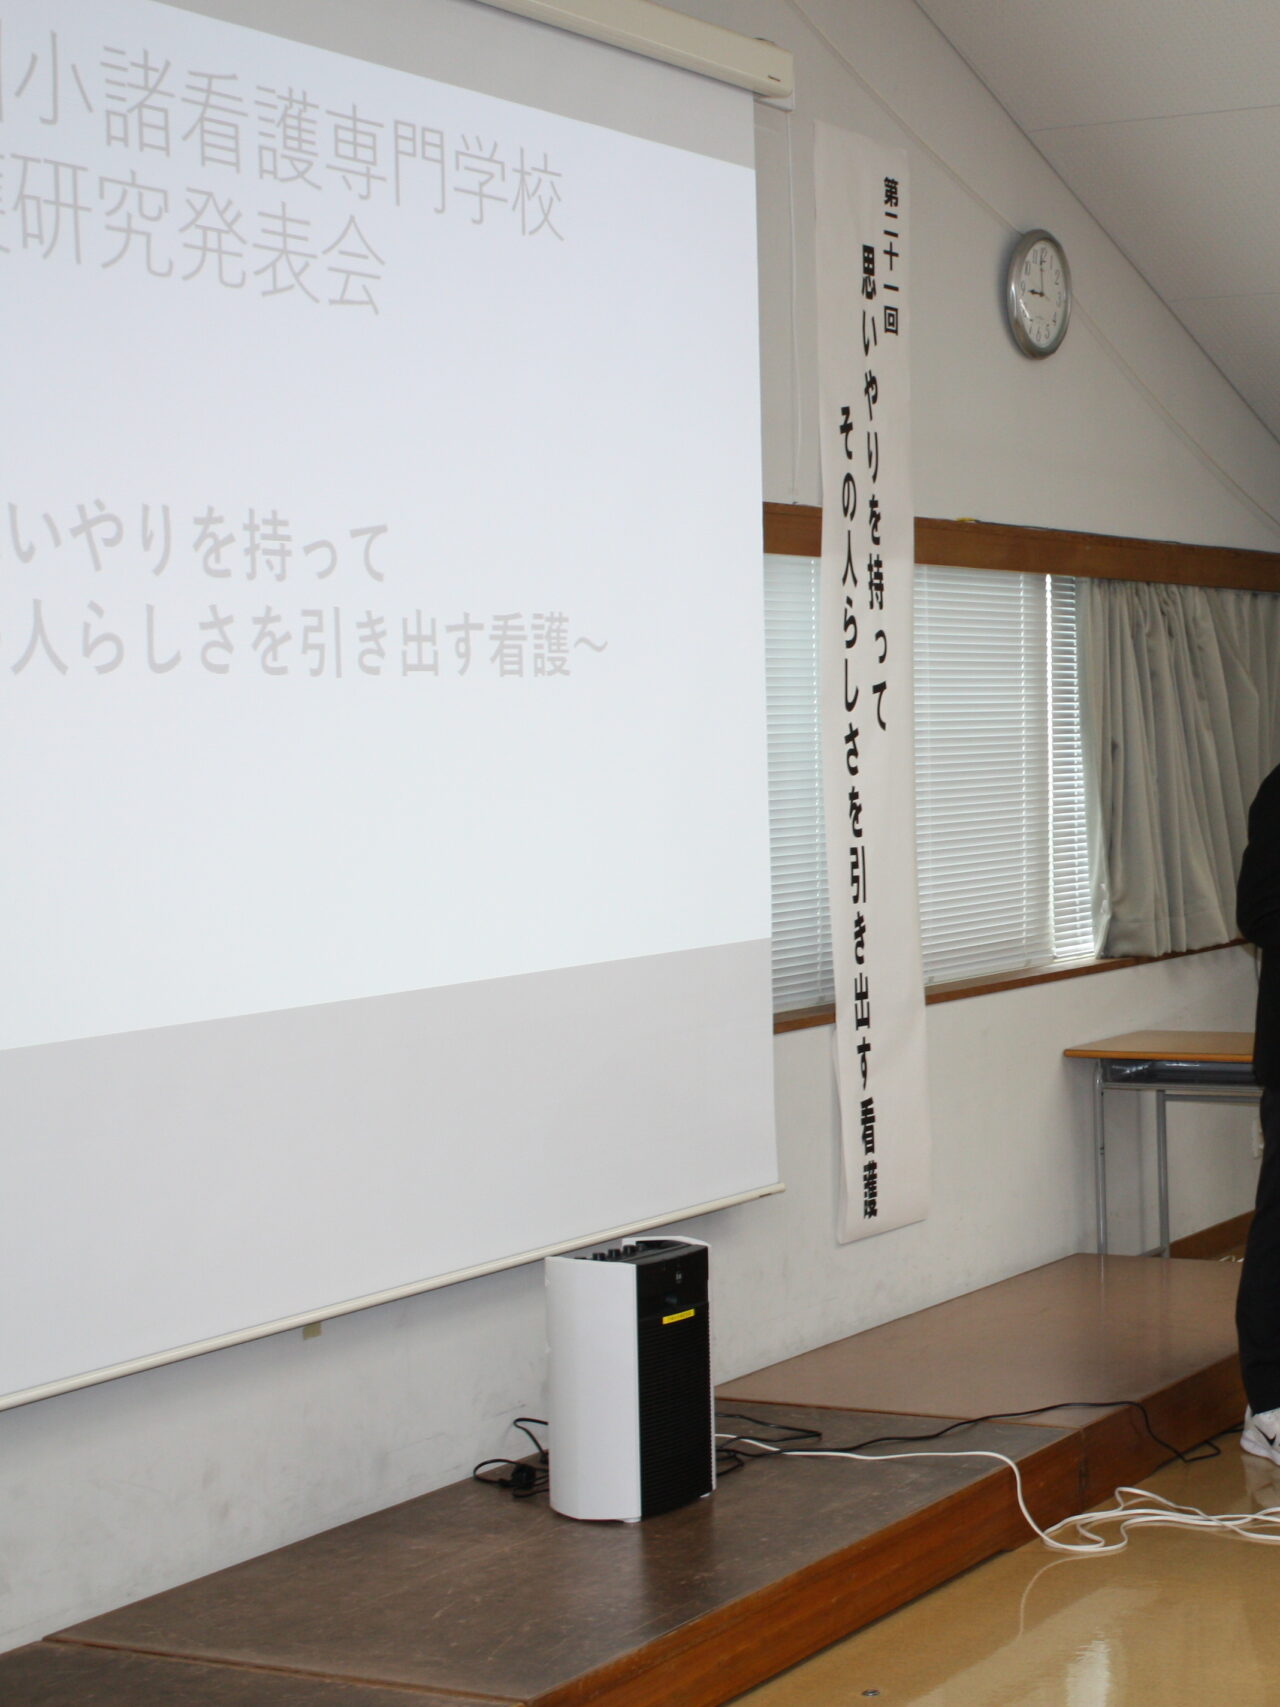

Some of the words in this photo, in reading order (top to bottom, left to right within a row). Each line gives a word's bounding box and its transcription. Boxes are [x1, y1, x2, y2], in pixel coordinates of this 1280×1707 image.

[0, 18, 565, 242] 小諸看護専門学校
[0, 151, 387, 315] 研究発表会
[8, 498, 389, 583] いやりを持って
[861, 245, 887, 731] 思いやりを持って
[839, 406, 878, 1219] その人らしさを引き出す看護
